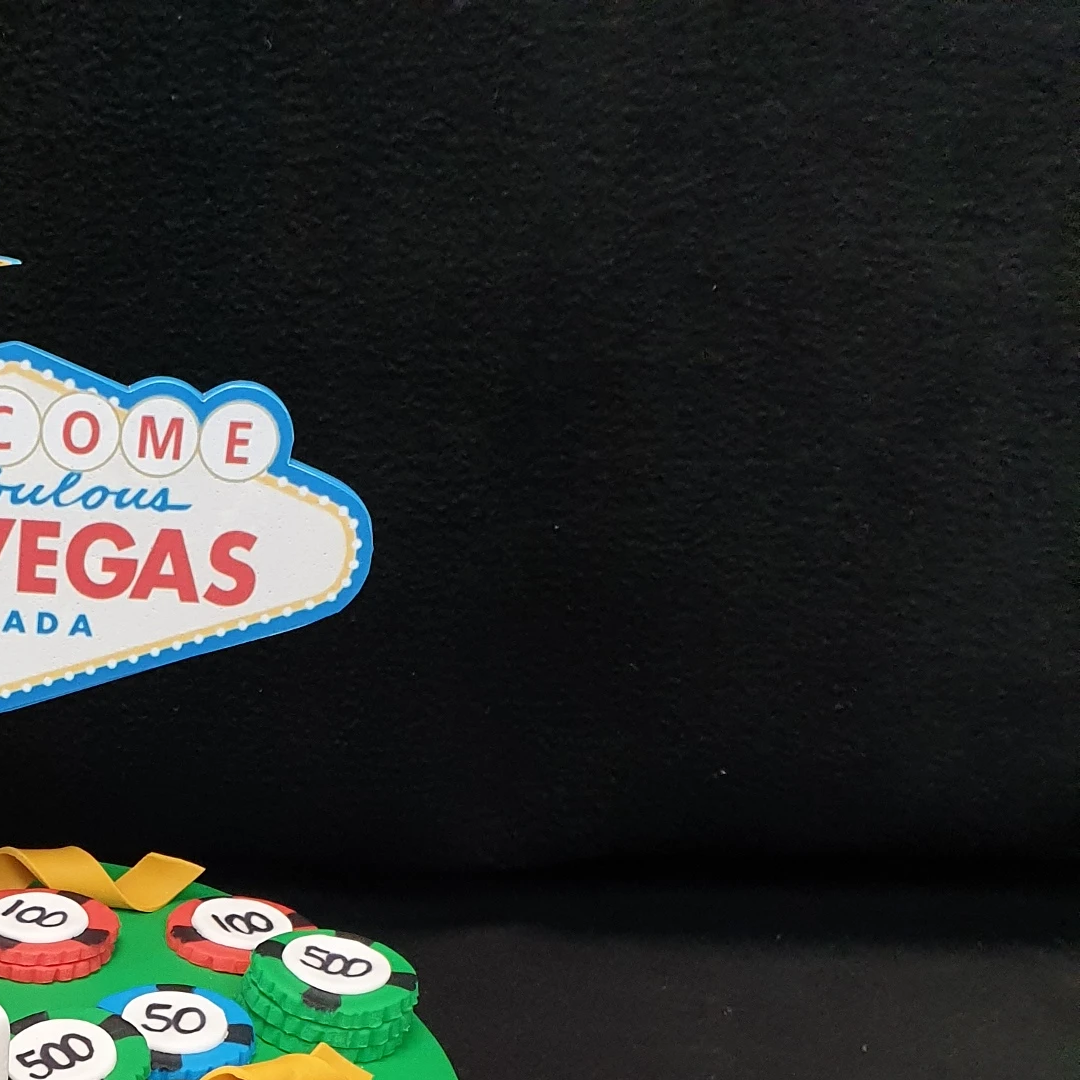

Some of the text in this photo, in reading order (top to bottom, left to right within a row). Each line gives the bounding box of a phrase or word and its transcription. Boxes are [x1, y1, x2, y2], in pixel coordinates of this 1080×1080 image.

[1, 899, 68, 928] 100
[211, 911, 274, 935] 100
[299, 945, 373, 978] 500
[140, 1002, 206, 1034] 50
[15, 1032, 94, 1079] 500
